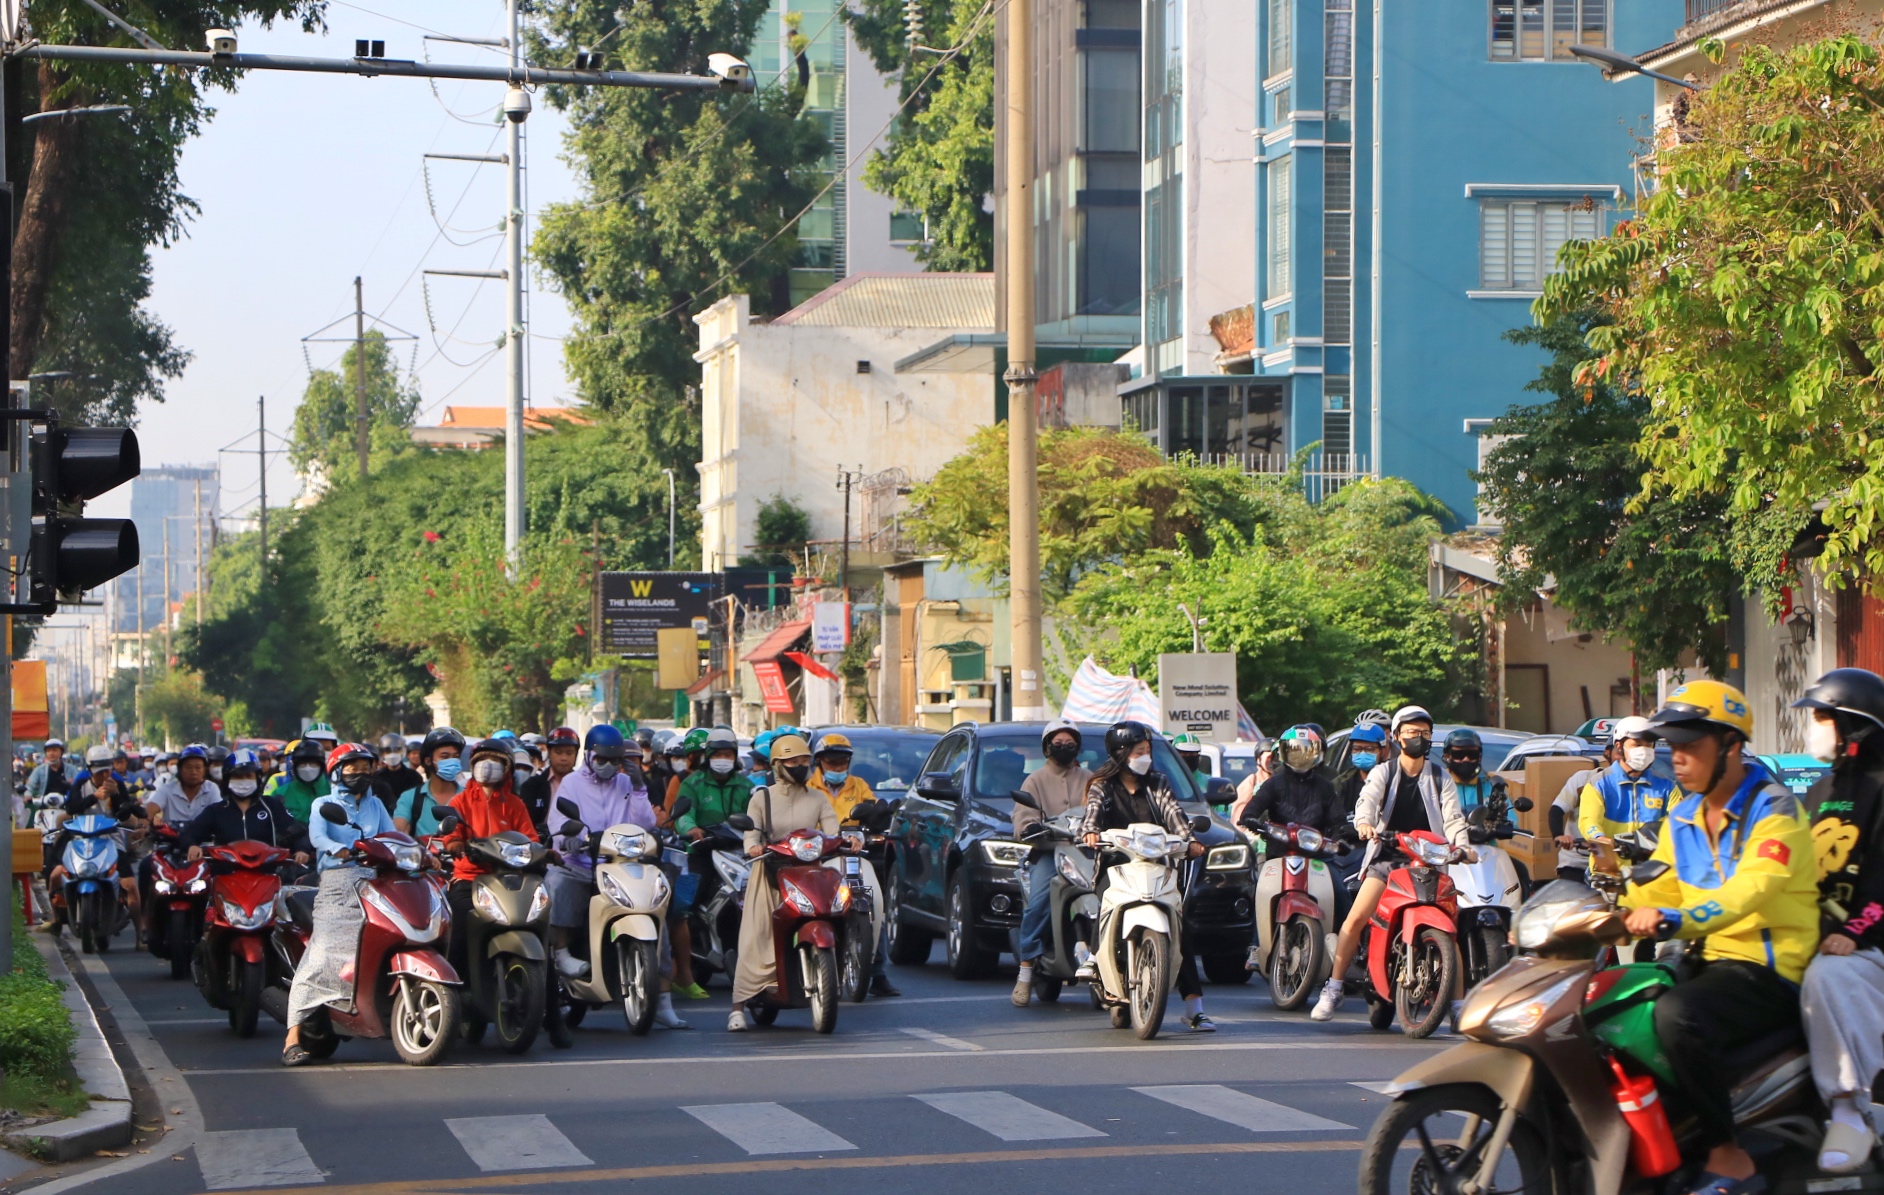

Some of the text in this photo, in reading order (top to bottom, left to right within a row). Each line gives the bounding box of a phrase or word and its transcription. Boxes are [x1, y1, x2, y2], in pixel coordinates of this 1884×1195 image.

[629, 579, 653, 598] W
[608, 598, 676, 607] THE WISELANDS
[1671, 686, 1688, 697] e
[1723, 693, 1747, 718] be
[1168, 709, 1231, 722] WELCOME
[1643, 793, 1664, 809] be
